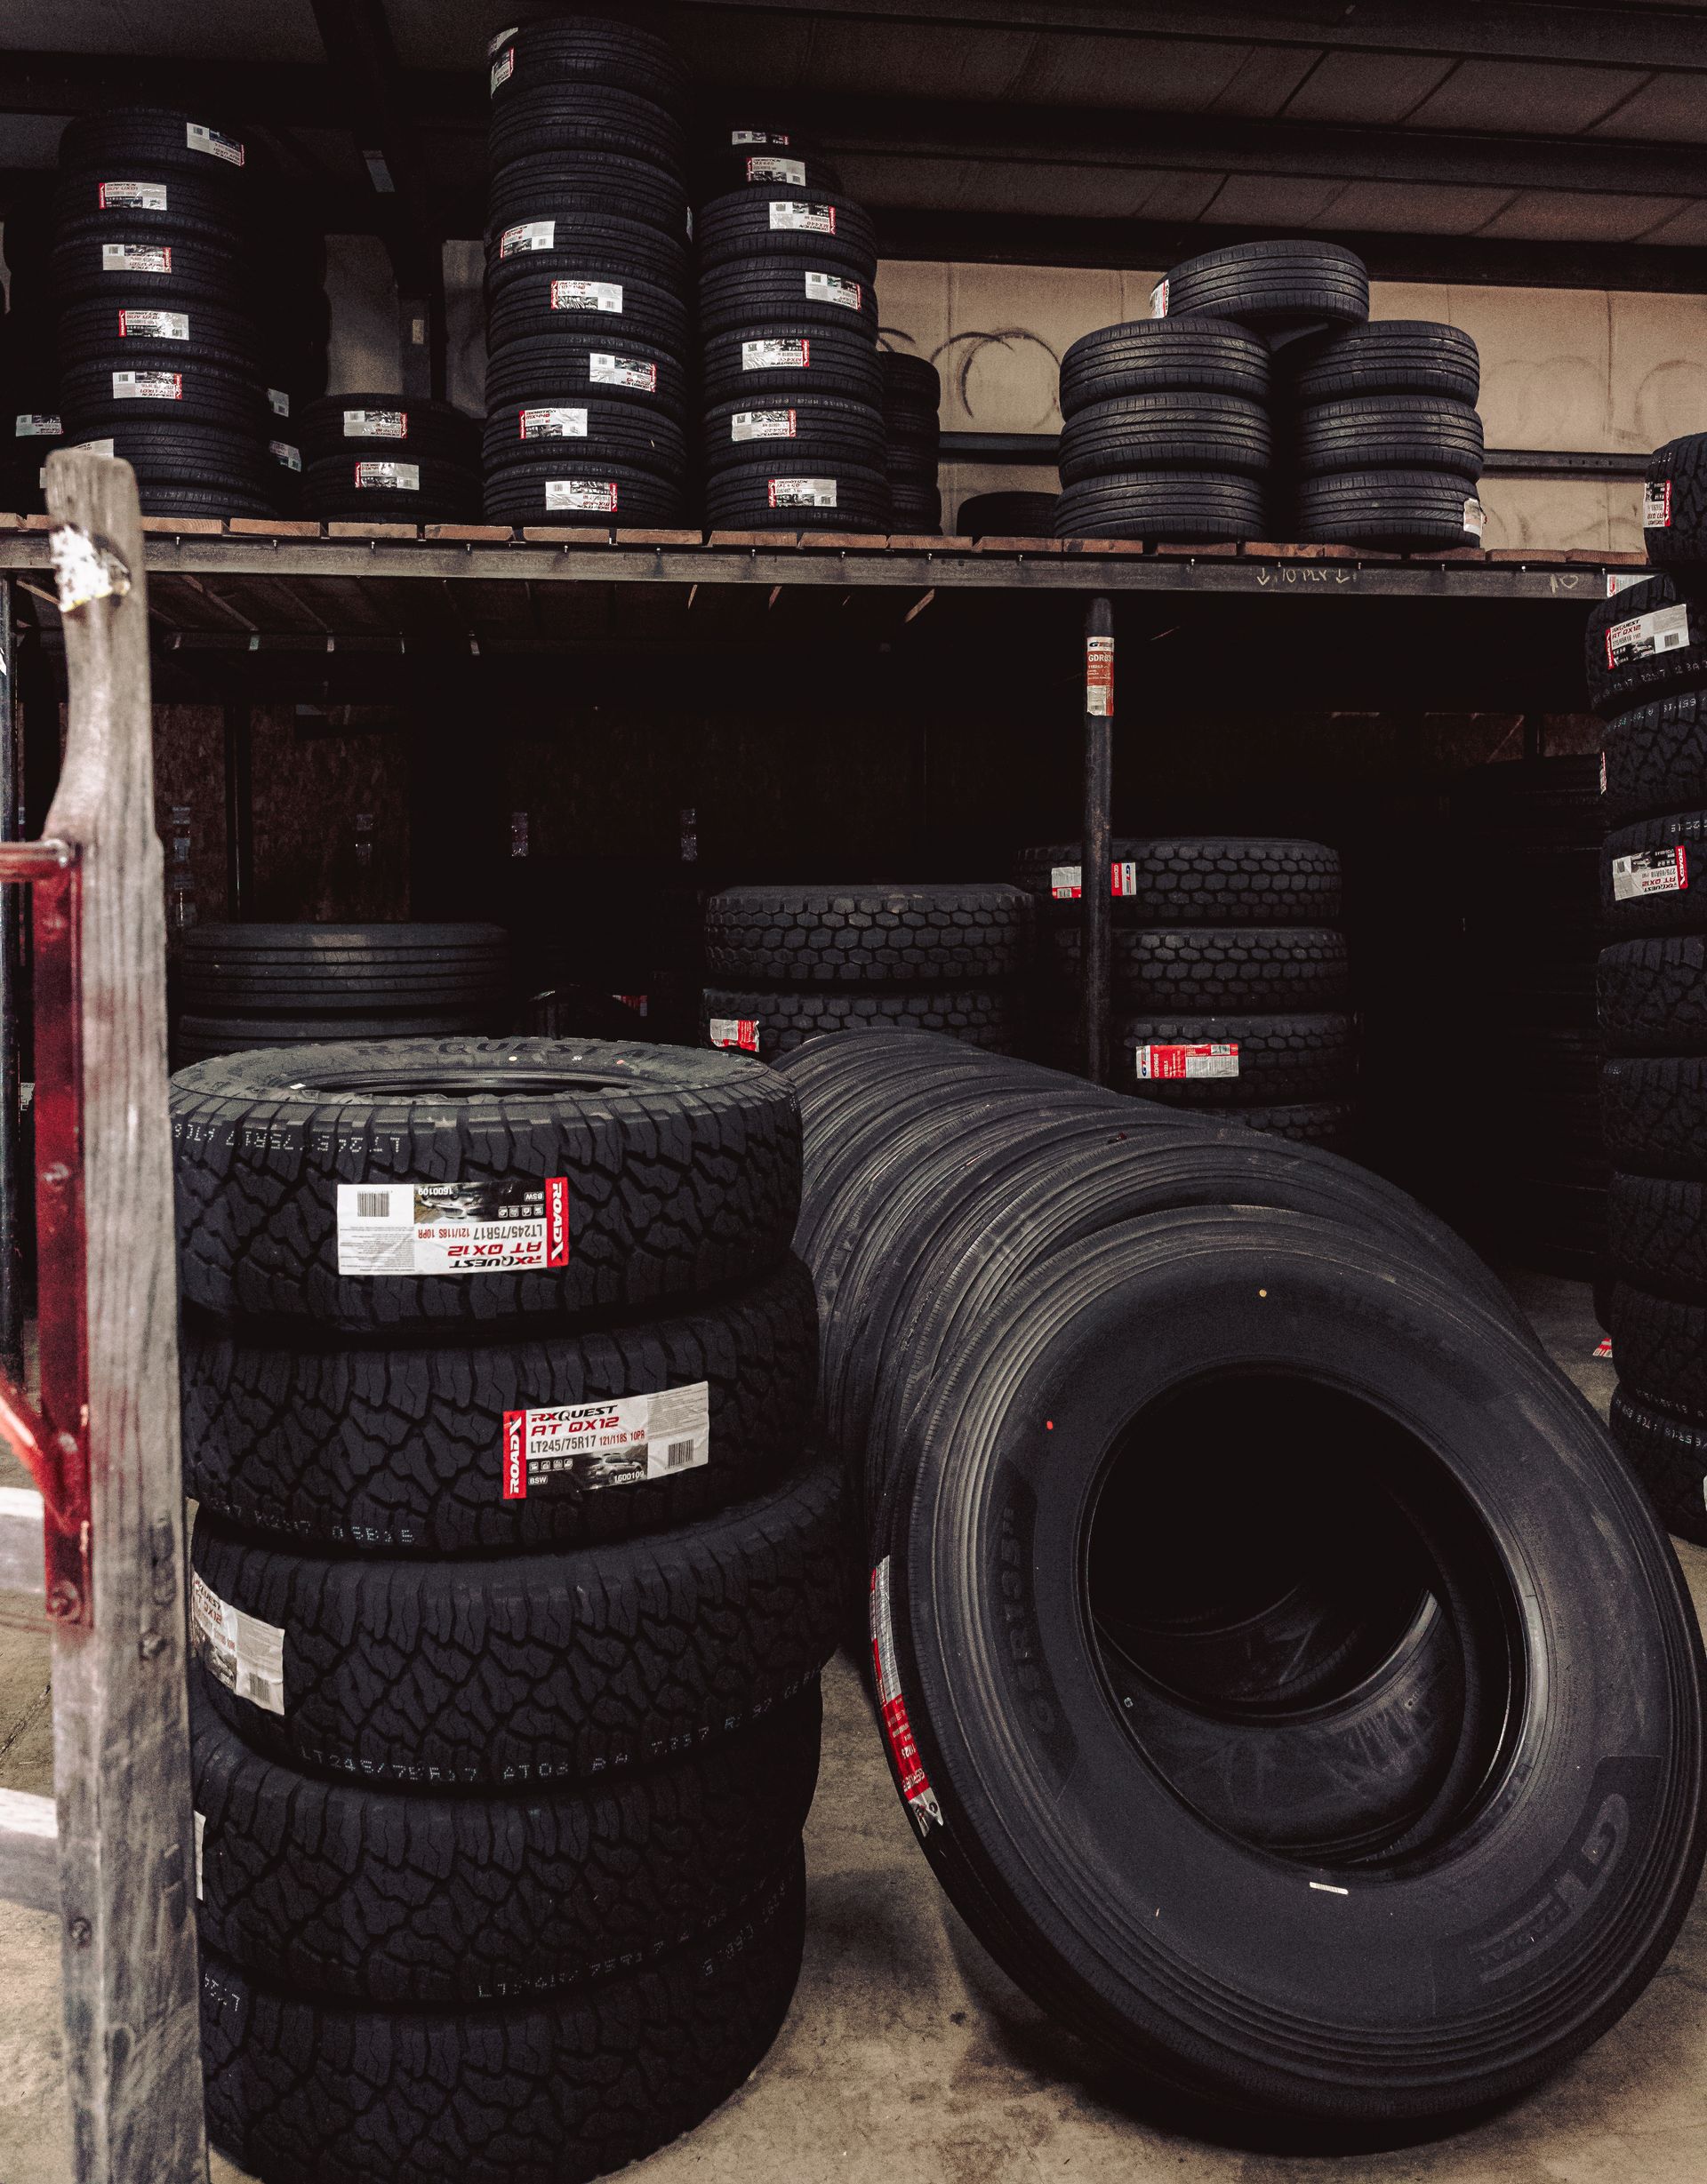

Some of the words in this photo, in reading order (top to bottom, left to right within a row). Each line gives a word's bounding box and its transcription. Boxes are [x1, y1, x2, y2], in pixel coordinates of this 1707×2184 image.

[1302, 568, 1327, 582] PLY
[1678, 848, 1686, 886] ROADX
[418, 1187, 453, 1196] 1600109
[525, 1192, 544, 1200] BSW
[551, 1182, 564, 1260] ROADX
[418, 1228, 436, 1239] 10PR
[473, 1224, 543, 1240] LT245/75R17
[447, 1244, 504, 1257] QX12
[510, 1241, 542, 1253] AT
[449, 1255, 543, 1268] RXQUEST
[531, 1404, 618, 1422] RXQUEST
[531, 1422, 561, 1437] AT
[569, 1416, 621, 1434] QX12
[531, 1436, 597, 1454] LT245/75R17
[599, 1433, 628, 1446] 121/118S
[630, 1430, 645, 1441] 10PR
[509, 1415, 523, 1494] ROADX
[530, 1476, 547, 1484] BSW
[613, 1470, 645, 1484] 1600109
